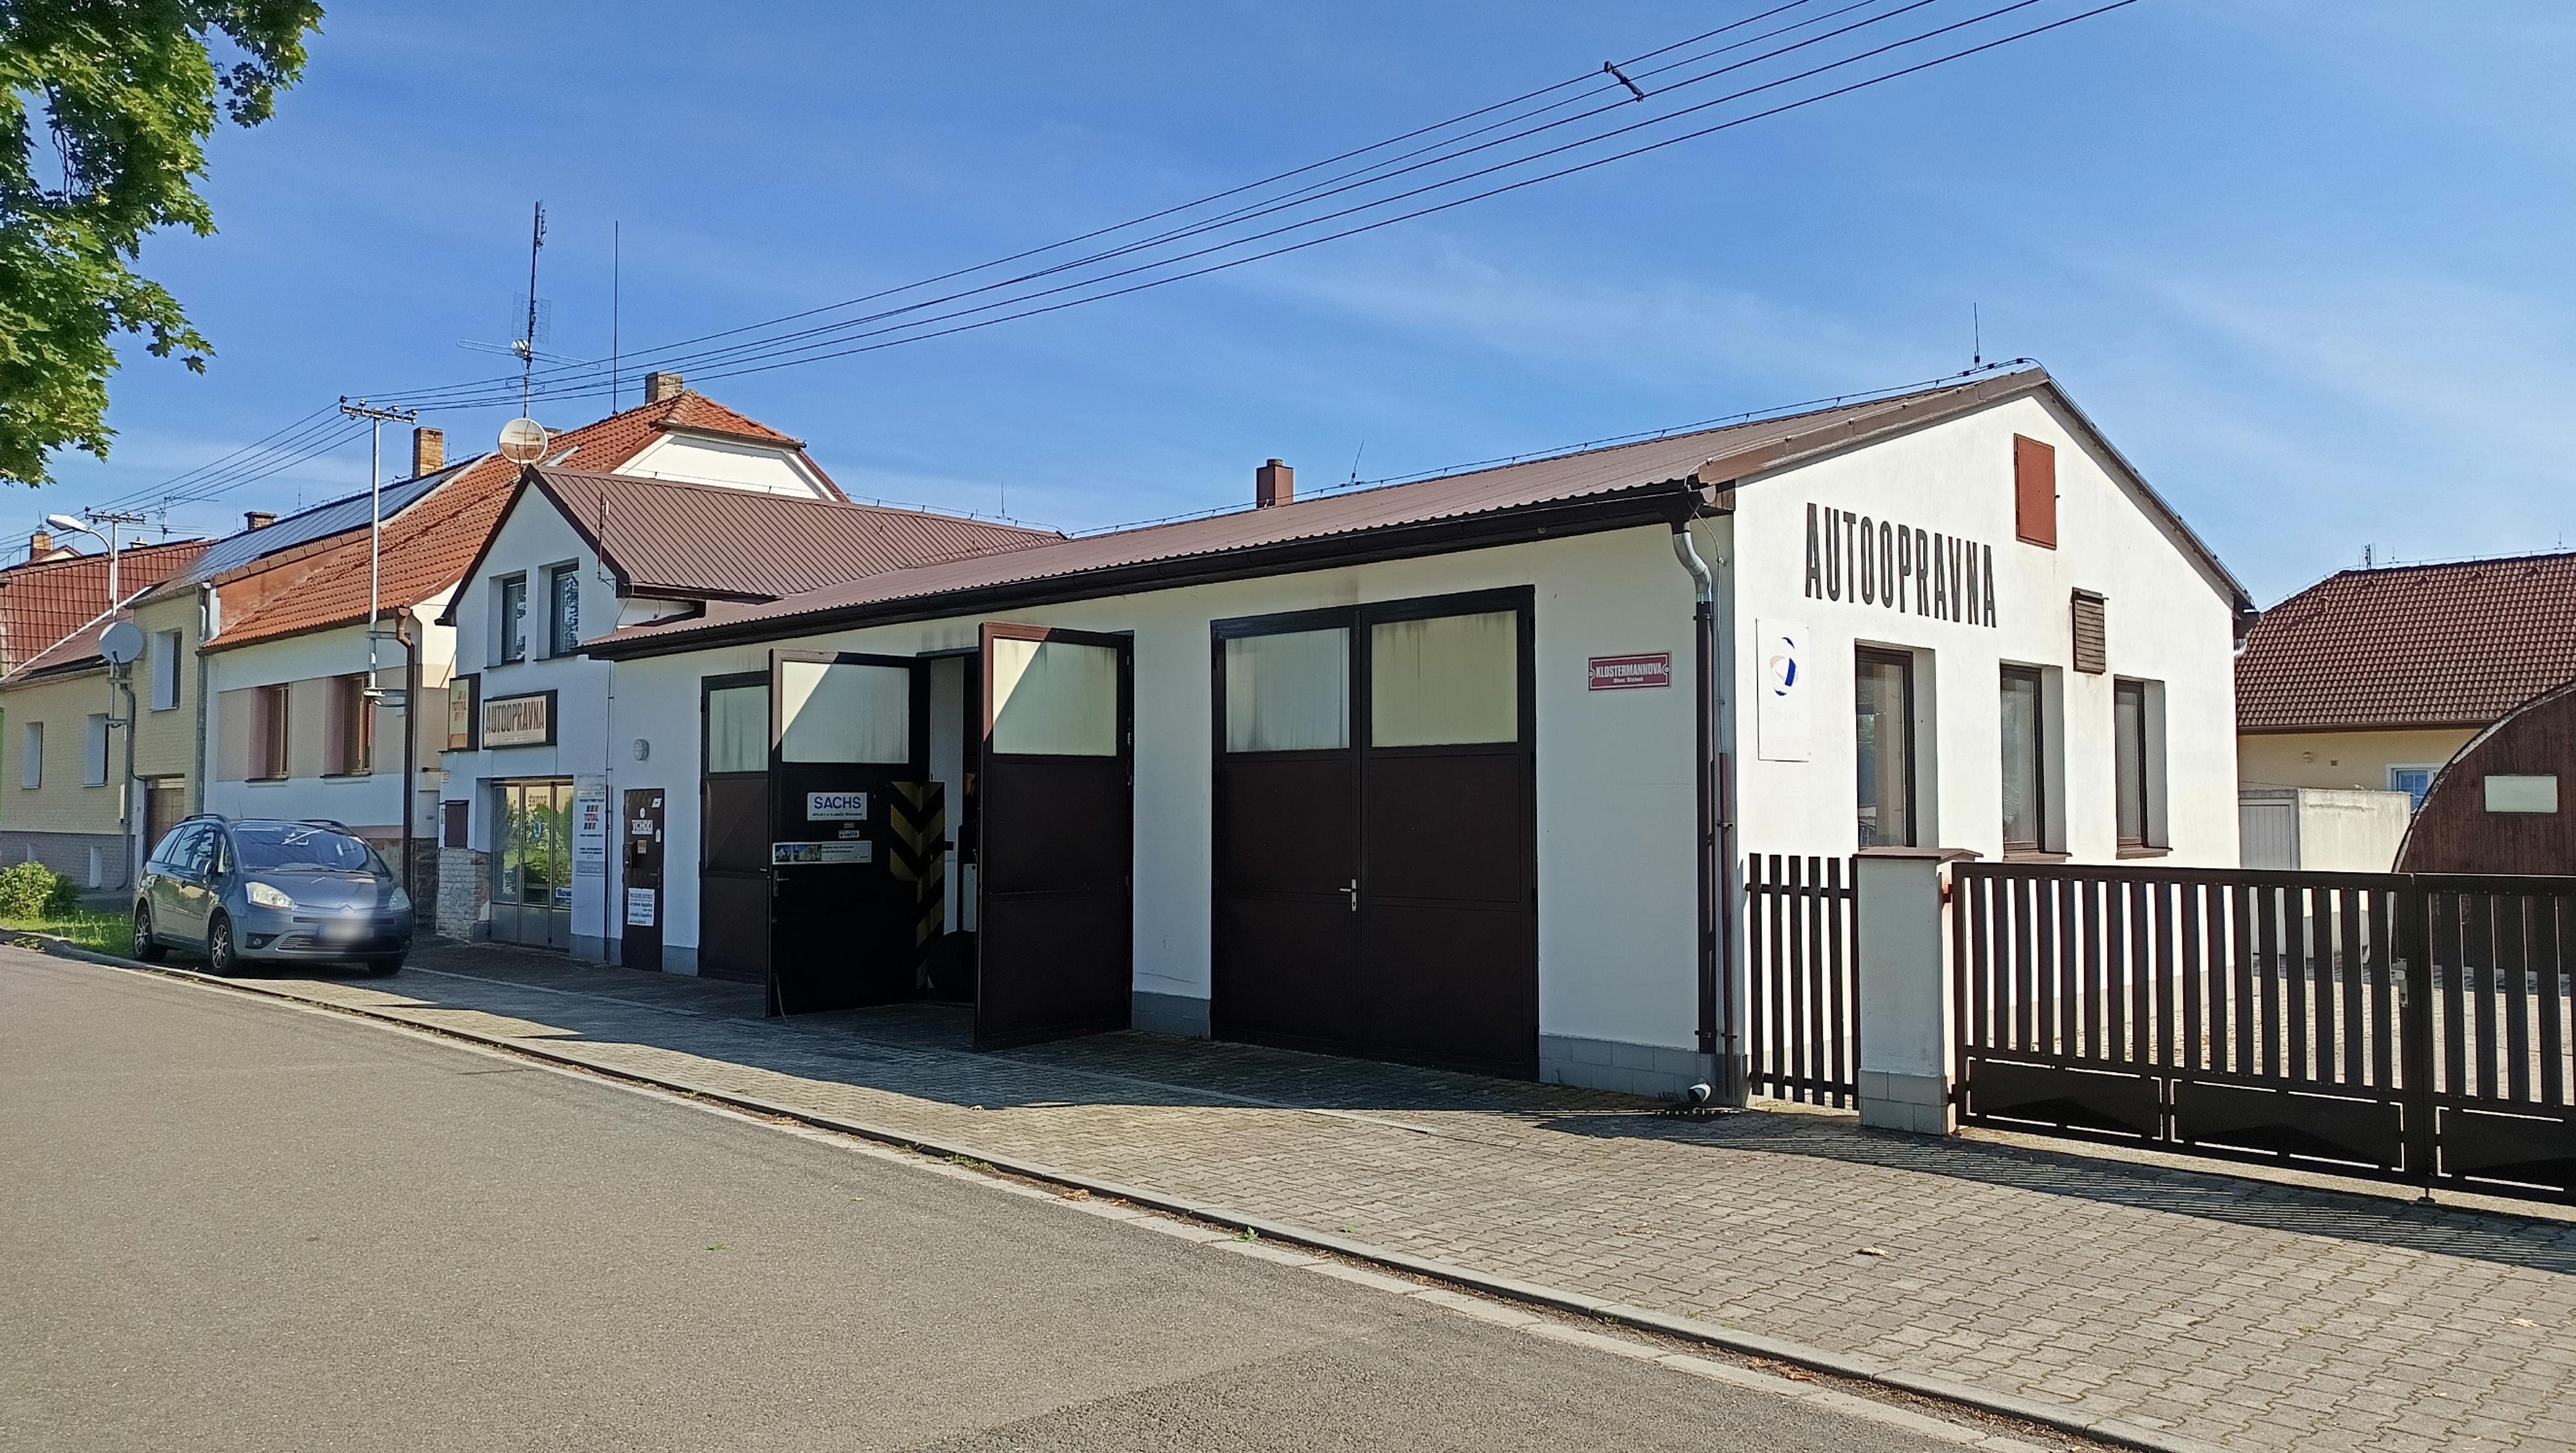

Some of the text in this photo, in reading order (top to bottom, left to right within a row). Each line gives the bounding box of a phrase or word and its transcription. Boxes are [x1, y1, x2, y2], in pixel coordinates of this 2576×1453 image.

[1805, 502, 1997, 628] AUTOOPRAVNA
[1596, 663, 1662, 678] KLOSTERMANNOVA
[486, 700, 545, 734] AUTOOPRAVNA
[813, 796, 862, 809] SACHS
